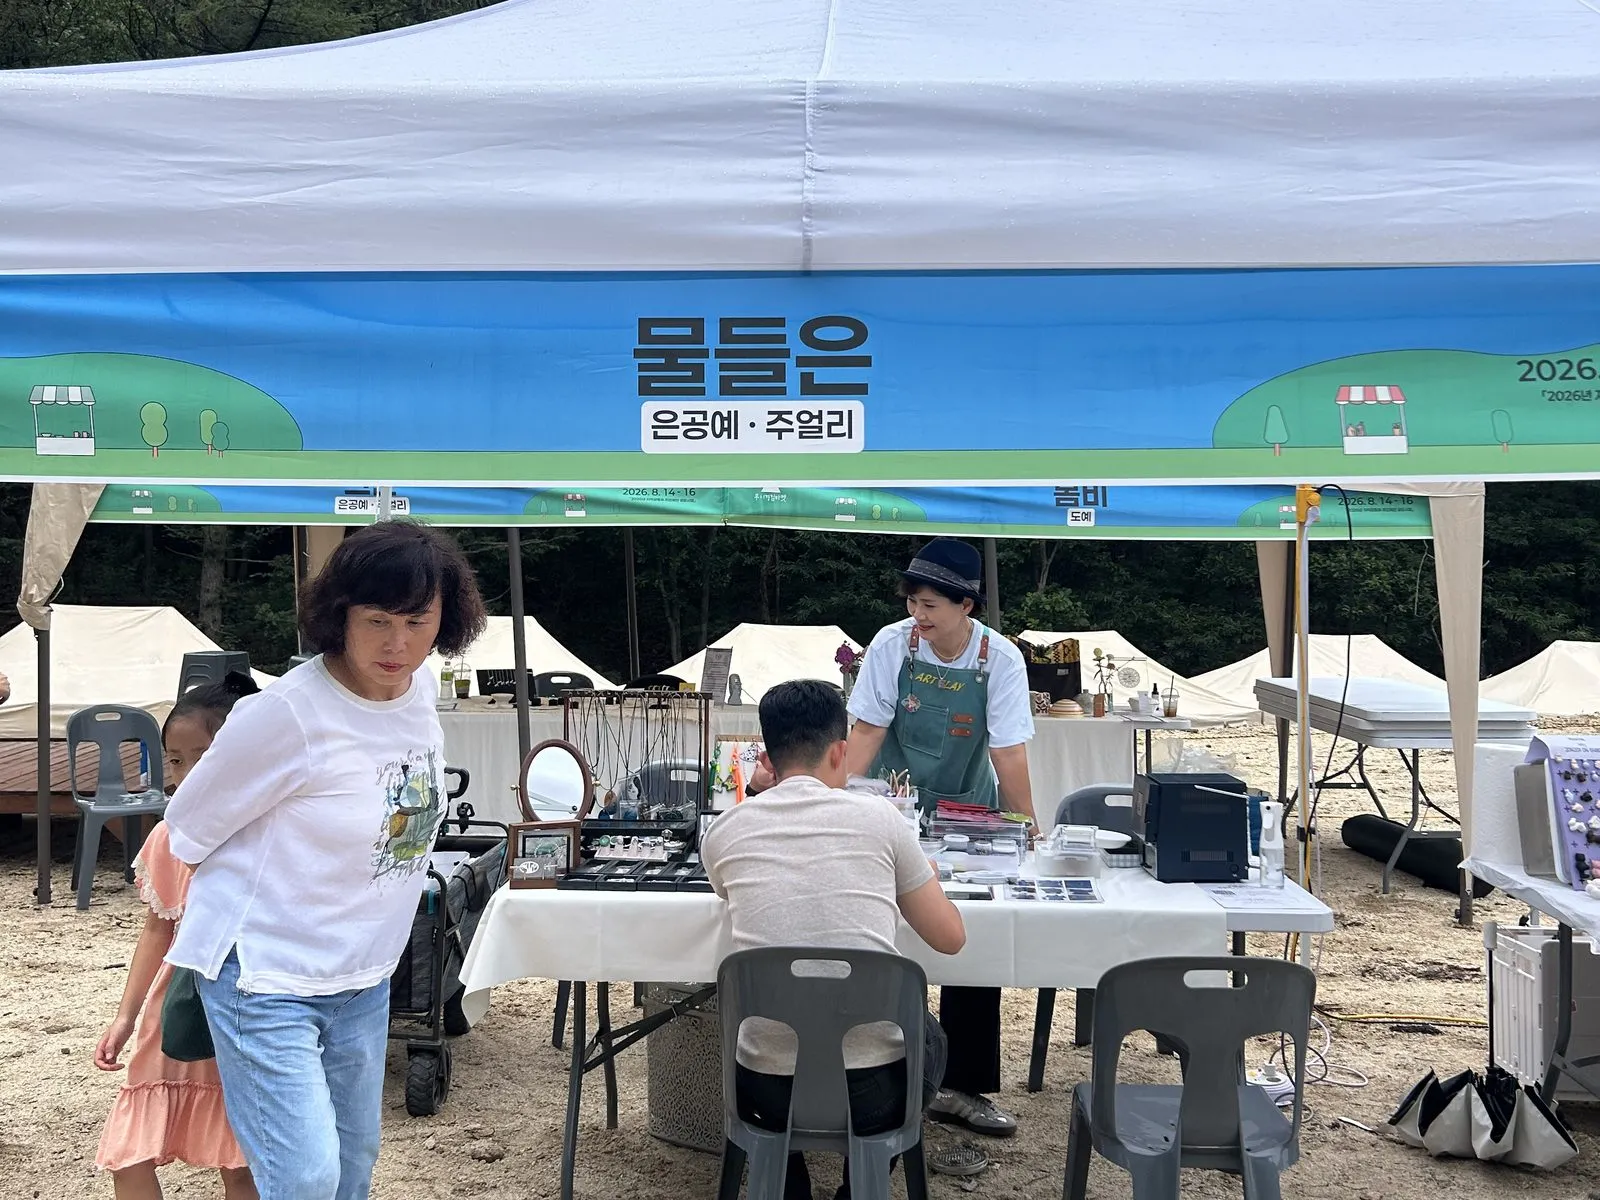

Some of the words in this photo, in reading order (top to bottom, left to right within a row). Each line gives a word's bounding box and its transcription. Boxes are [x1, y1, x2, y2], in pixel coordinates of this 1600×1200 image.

[633, 315, 872, 396] 물들은
[651, 409, 739, 440] 은공예
[765, 409, 853, 440] 주얼리
[622, 488, 650, 496] 2026.
[338, 499, 368, 510] 은공예
[1070, 511, 1092, 522] 도예
[915, 672, 938, 684] ART
[938, 680, 966, 692] LAY
